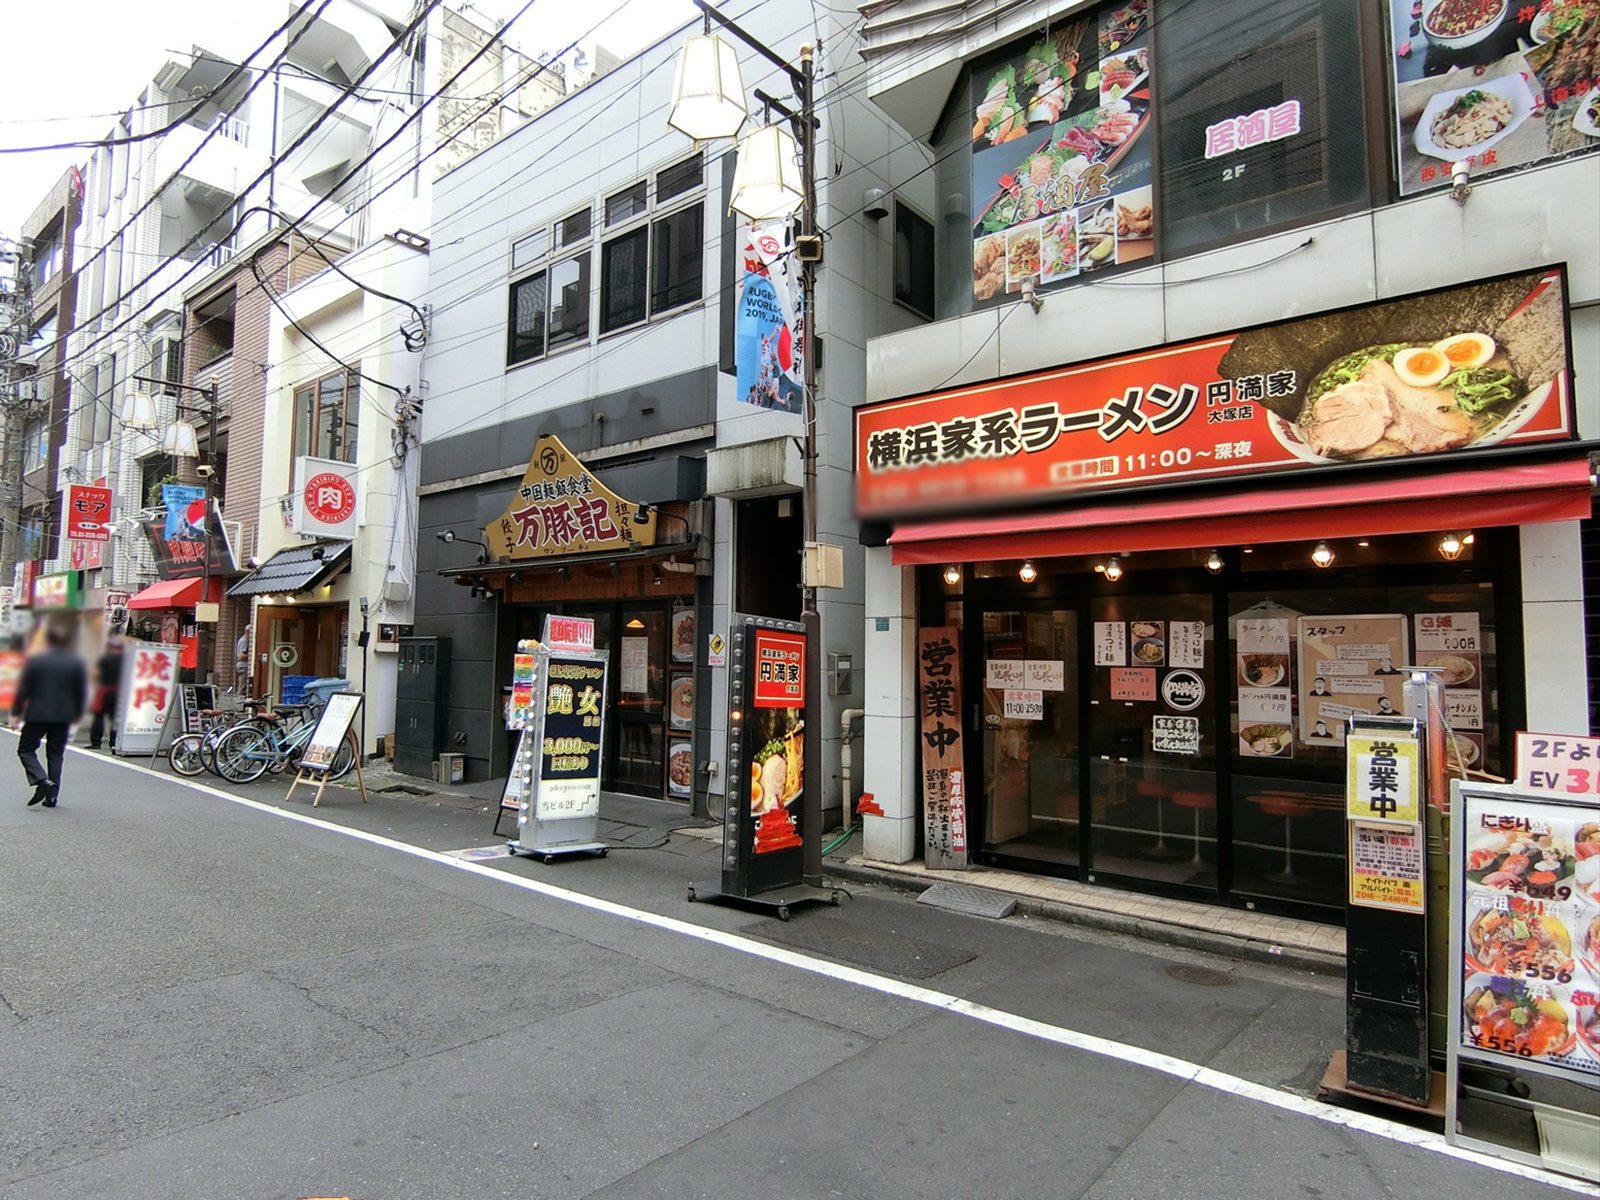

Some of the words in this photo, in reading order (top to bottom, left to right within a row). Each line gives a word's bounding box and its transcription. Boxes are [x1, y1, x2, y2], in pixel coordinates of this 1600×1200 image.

[1204, 100, 1300, 160] 居酒屋
[1222, 164, 1246, 183] 2F
[1010, 162, 1111, 225] 居酒屋
[746, 298, 777, 313] WORLD
[1207, 371, 1297, 406] 円満家
[867, 383, 1200, 475] 横浜家系ラーメン
[1207, 405, 1253, 425] 大塚店
[78, 491, 106, 500] スナック
[318, 486, 343, 510] 肉
[520, 472, 593, 506] 中国麺飯食堂
[74, 500, 107, 513] モア
[501, 518, 516, 554] 餃子
[510, 497, 620, 549] 万豚記
[615, 501, 635, 543] 担々麺
[1306, 625, 1346, 636] スタッフ
[133, 651, 172, 711] 焼肉
[760, 660, 800, 683] 円満家
[921, 637, 961, 759] 営業中
[1369, 740, 1399, 818] 営業中
[1529, 771, 1560, 789] EV
[1566, 768, 1600, 794] 3
[1508, 959, 1572, 984] ¥556
[1468, 1031, 1533, 1057] ¥556
